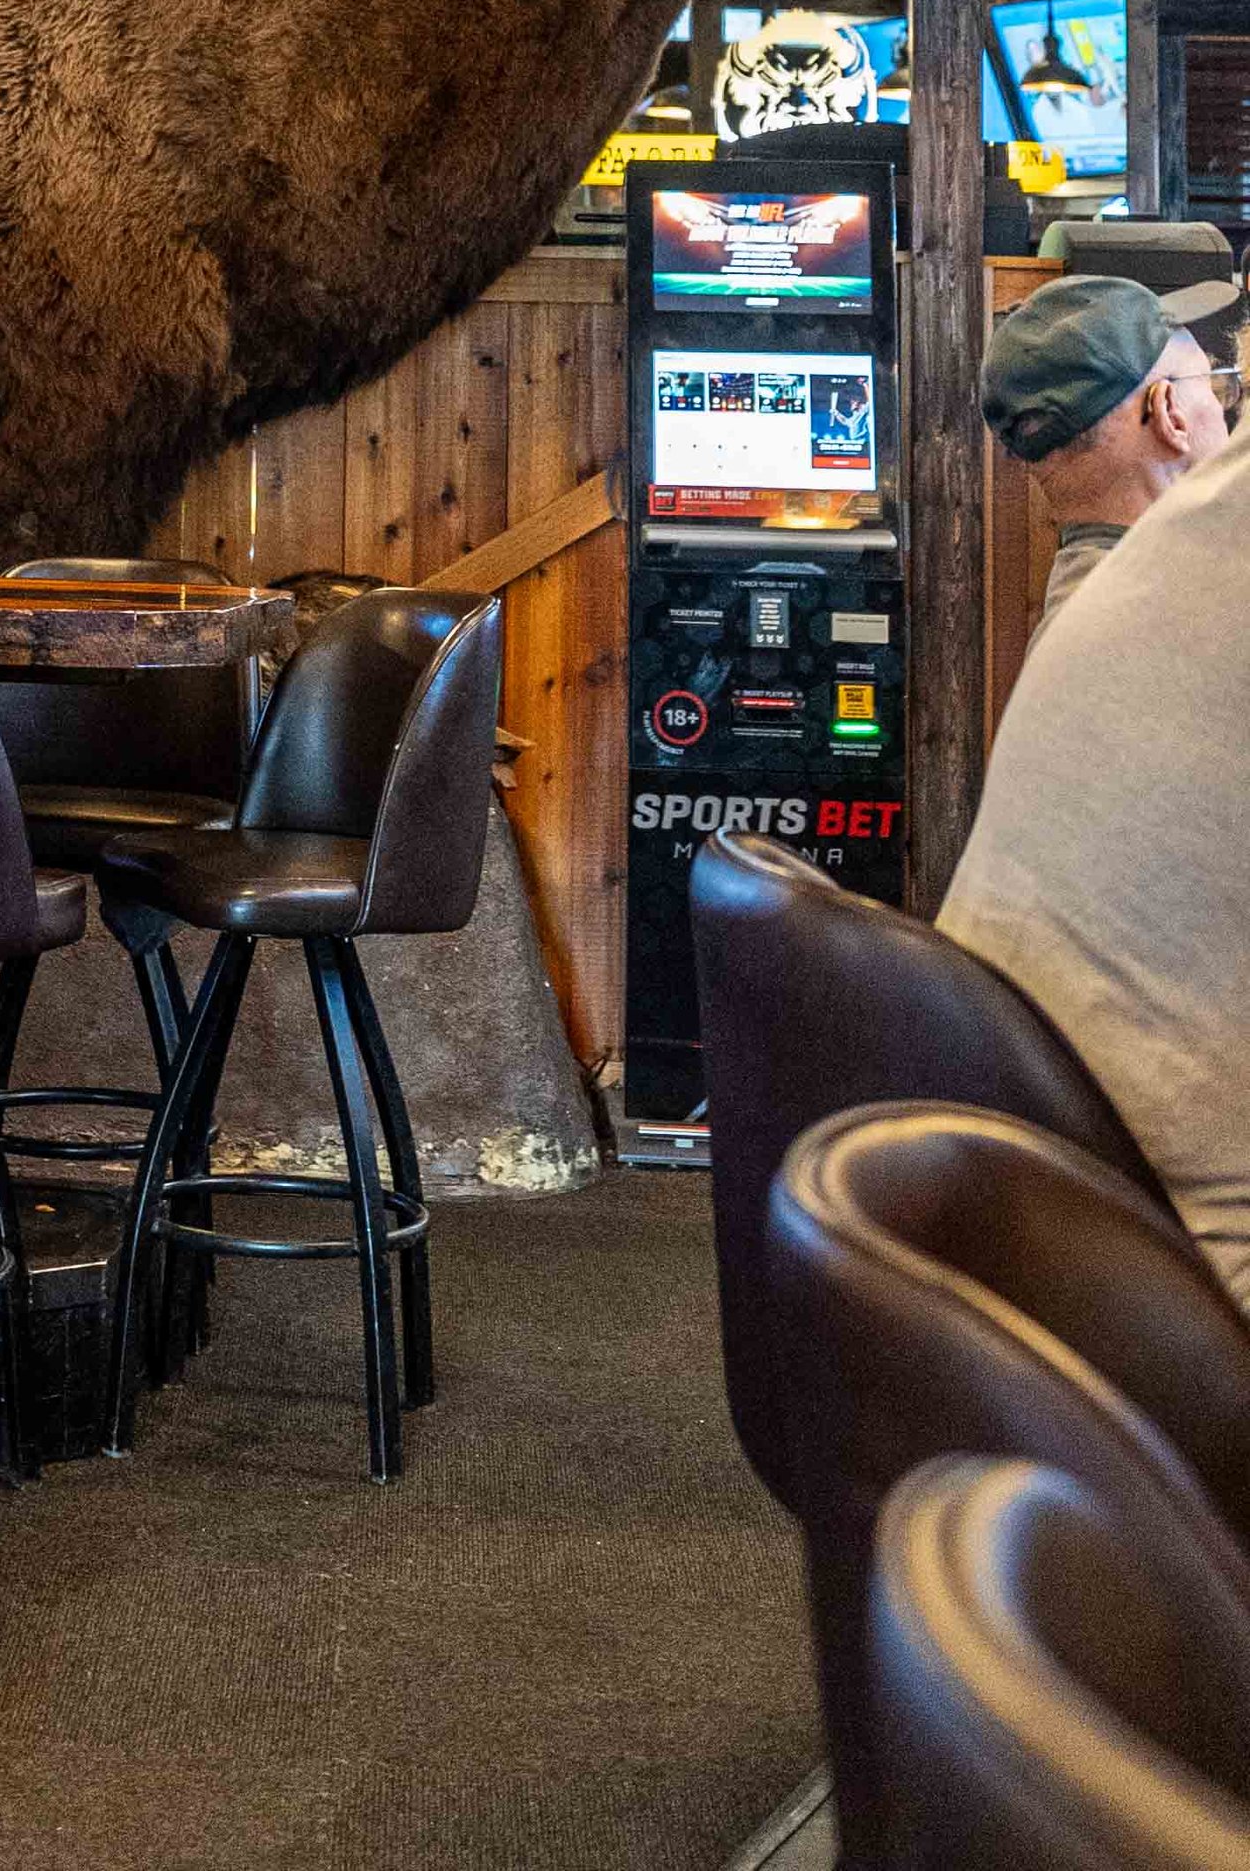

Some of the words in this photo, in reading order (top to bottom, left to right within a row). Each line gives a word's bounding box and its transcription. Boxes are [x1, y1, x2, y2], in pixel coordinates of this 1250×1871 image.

[663, 708, 700, 727] 18+
[632, 793, 808, 835] SPORTS
[816, 800, 901, 838] BET
